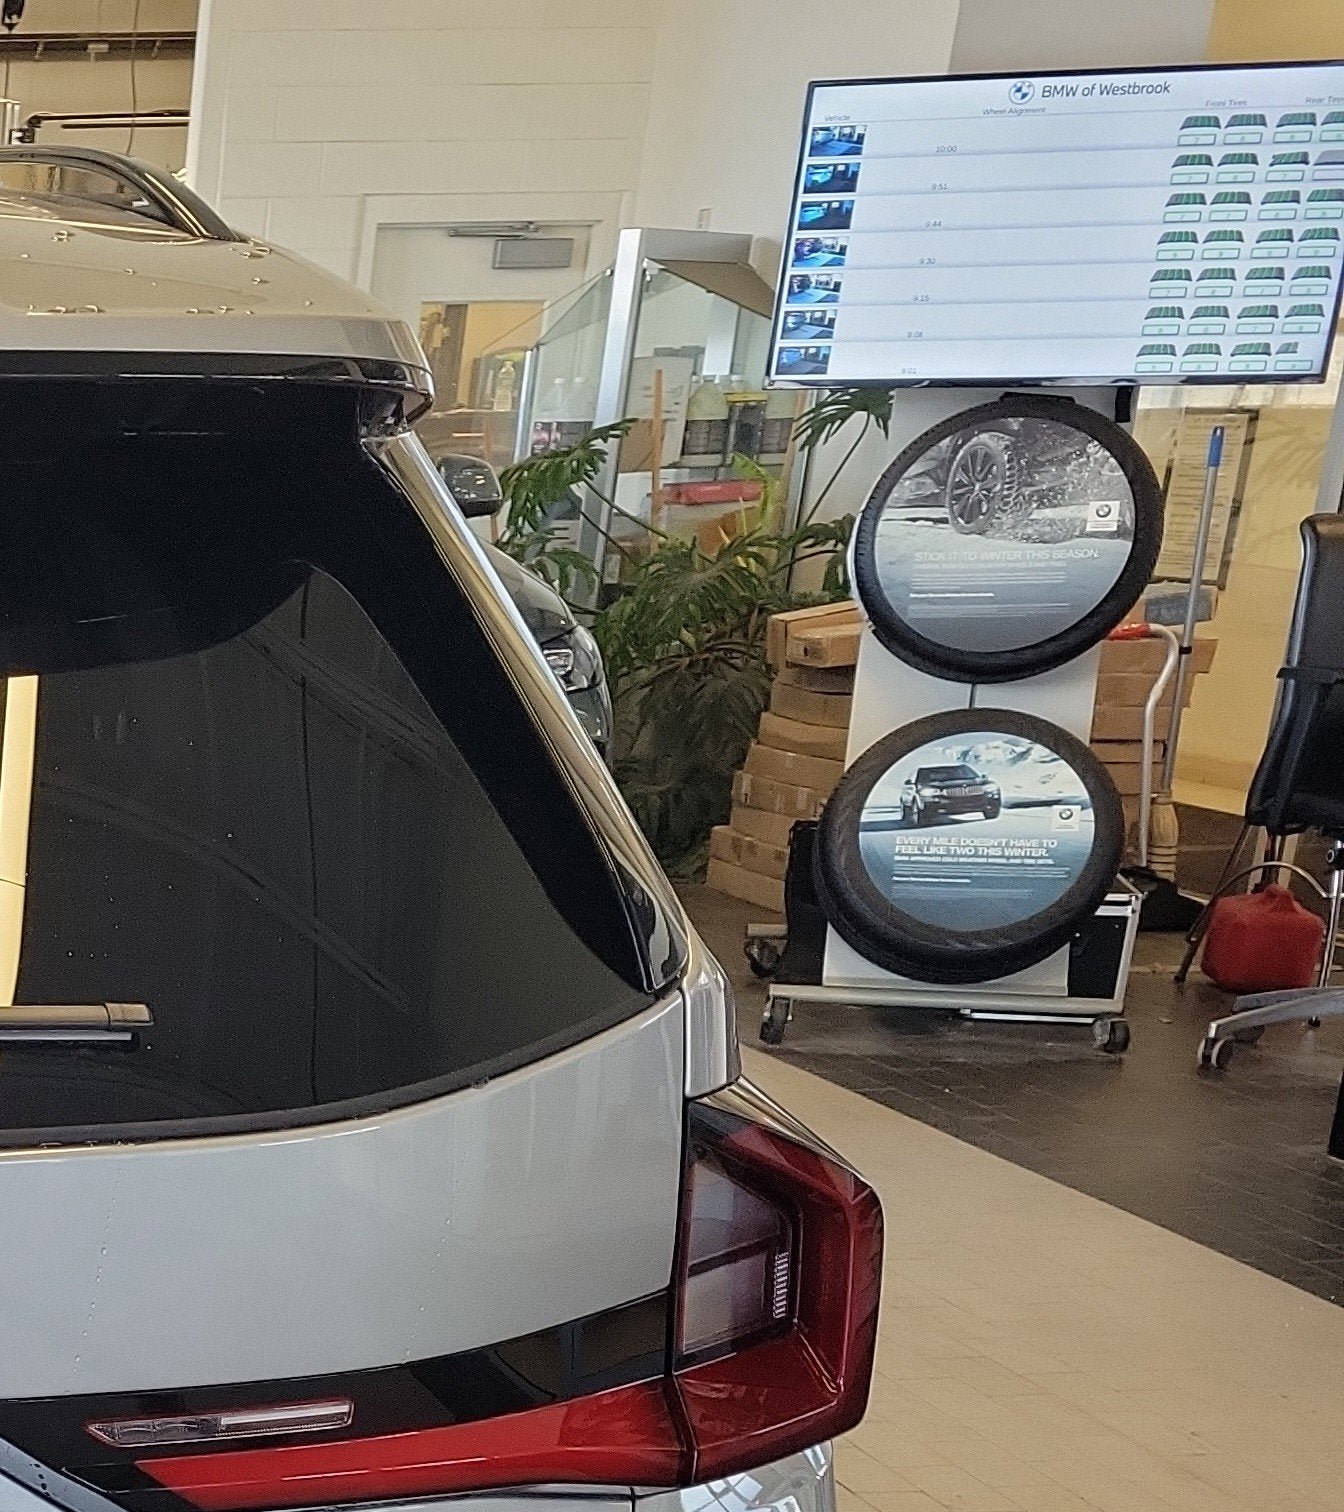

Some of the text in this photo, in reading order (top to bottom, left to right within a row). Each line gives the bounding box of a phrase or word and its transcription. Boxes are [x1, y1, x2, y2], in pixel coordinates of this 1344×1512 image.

[1042, 81, 1171, 98] BMW of Westbrook
[824, 114, 851, 122] Vehicle
[962, 551, 977, 561] TO
[1026, 550, 1050, 560] THIS
[896, 836, 1058, 848] EVERY MILE DOESN'T HAVE TO
[895, 845, 921, 854] FEEL
[924, 846, 947, 854] LIKE
[949, 846, 975, 855] TWO
[977, 847, 1002, 856] THIS
